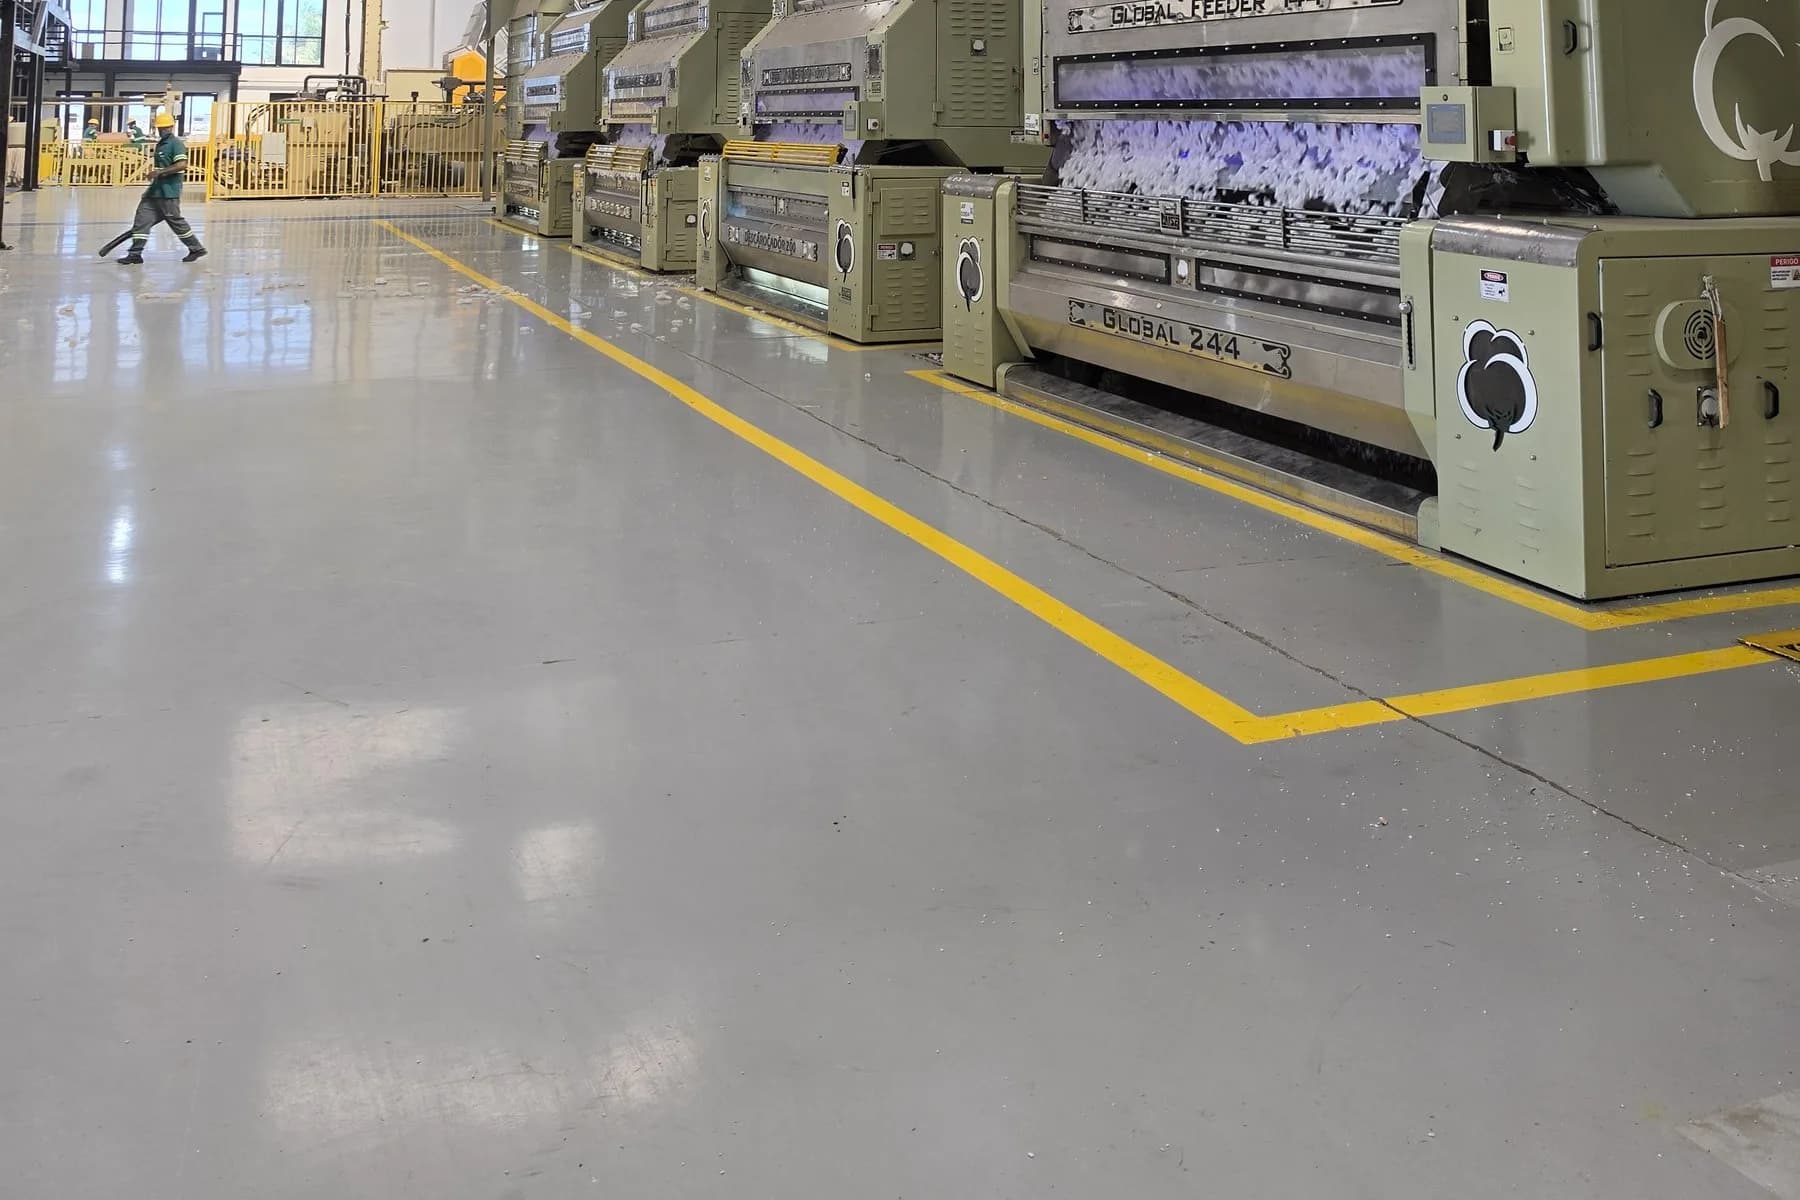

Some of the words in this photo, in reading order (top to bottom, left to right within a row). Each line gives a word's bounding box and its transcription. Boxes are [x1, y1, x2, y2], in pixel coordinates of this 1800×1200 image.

[1111, 4, 1177, 25] GLOBAL
[1103, 307, 1180, 346] GLOBAL
[1190, 326, 1240, 360] 244
